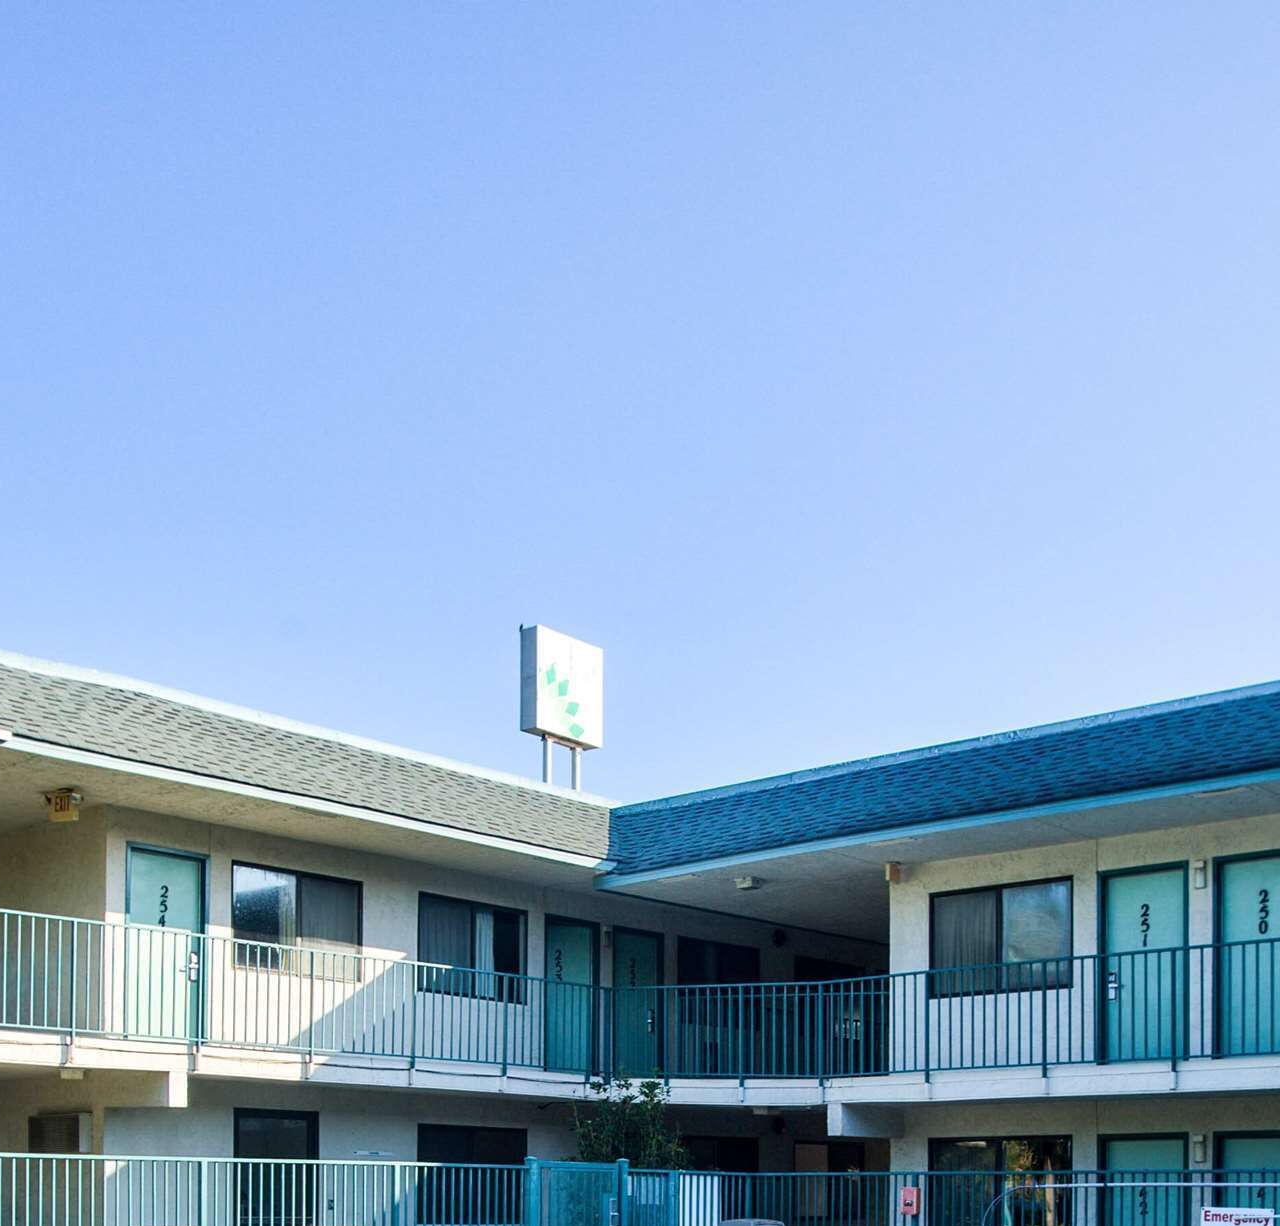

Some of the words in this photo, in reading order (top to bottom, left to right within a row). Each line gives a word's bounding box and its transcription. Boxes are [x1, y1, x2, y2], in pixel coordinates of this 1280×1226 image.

[55, 794, 70, 812] EXIT
[158, 884, 169, 928] 254
[1140, 903, 1150, 947] 251
[1258, 889, 1269, 934] 250
